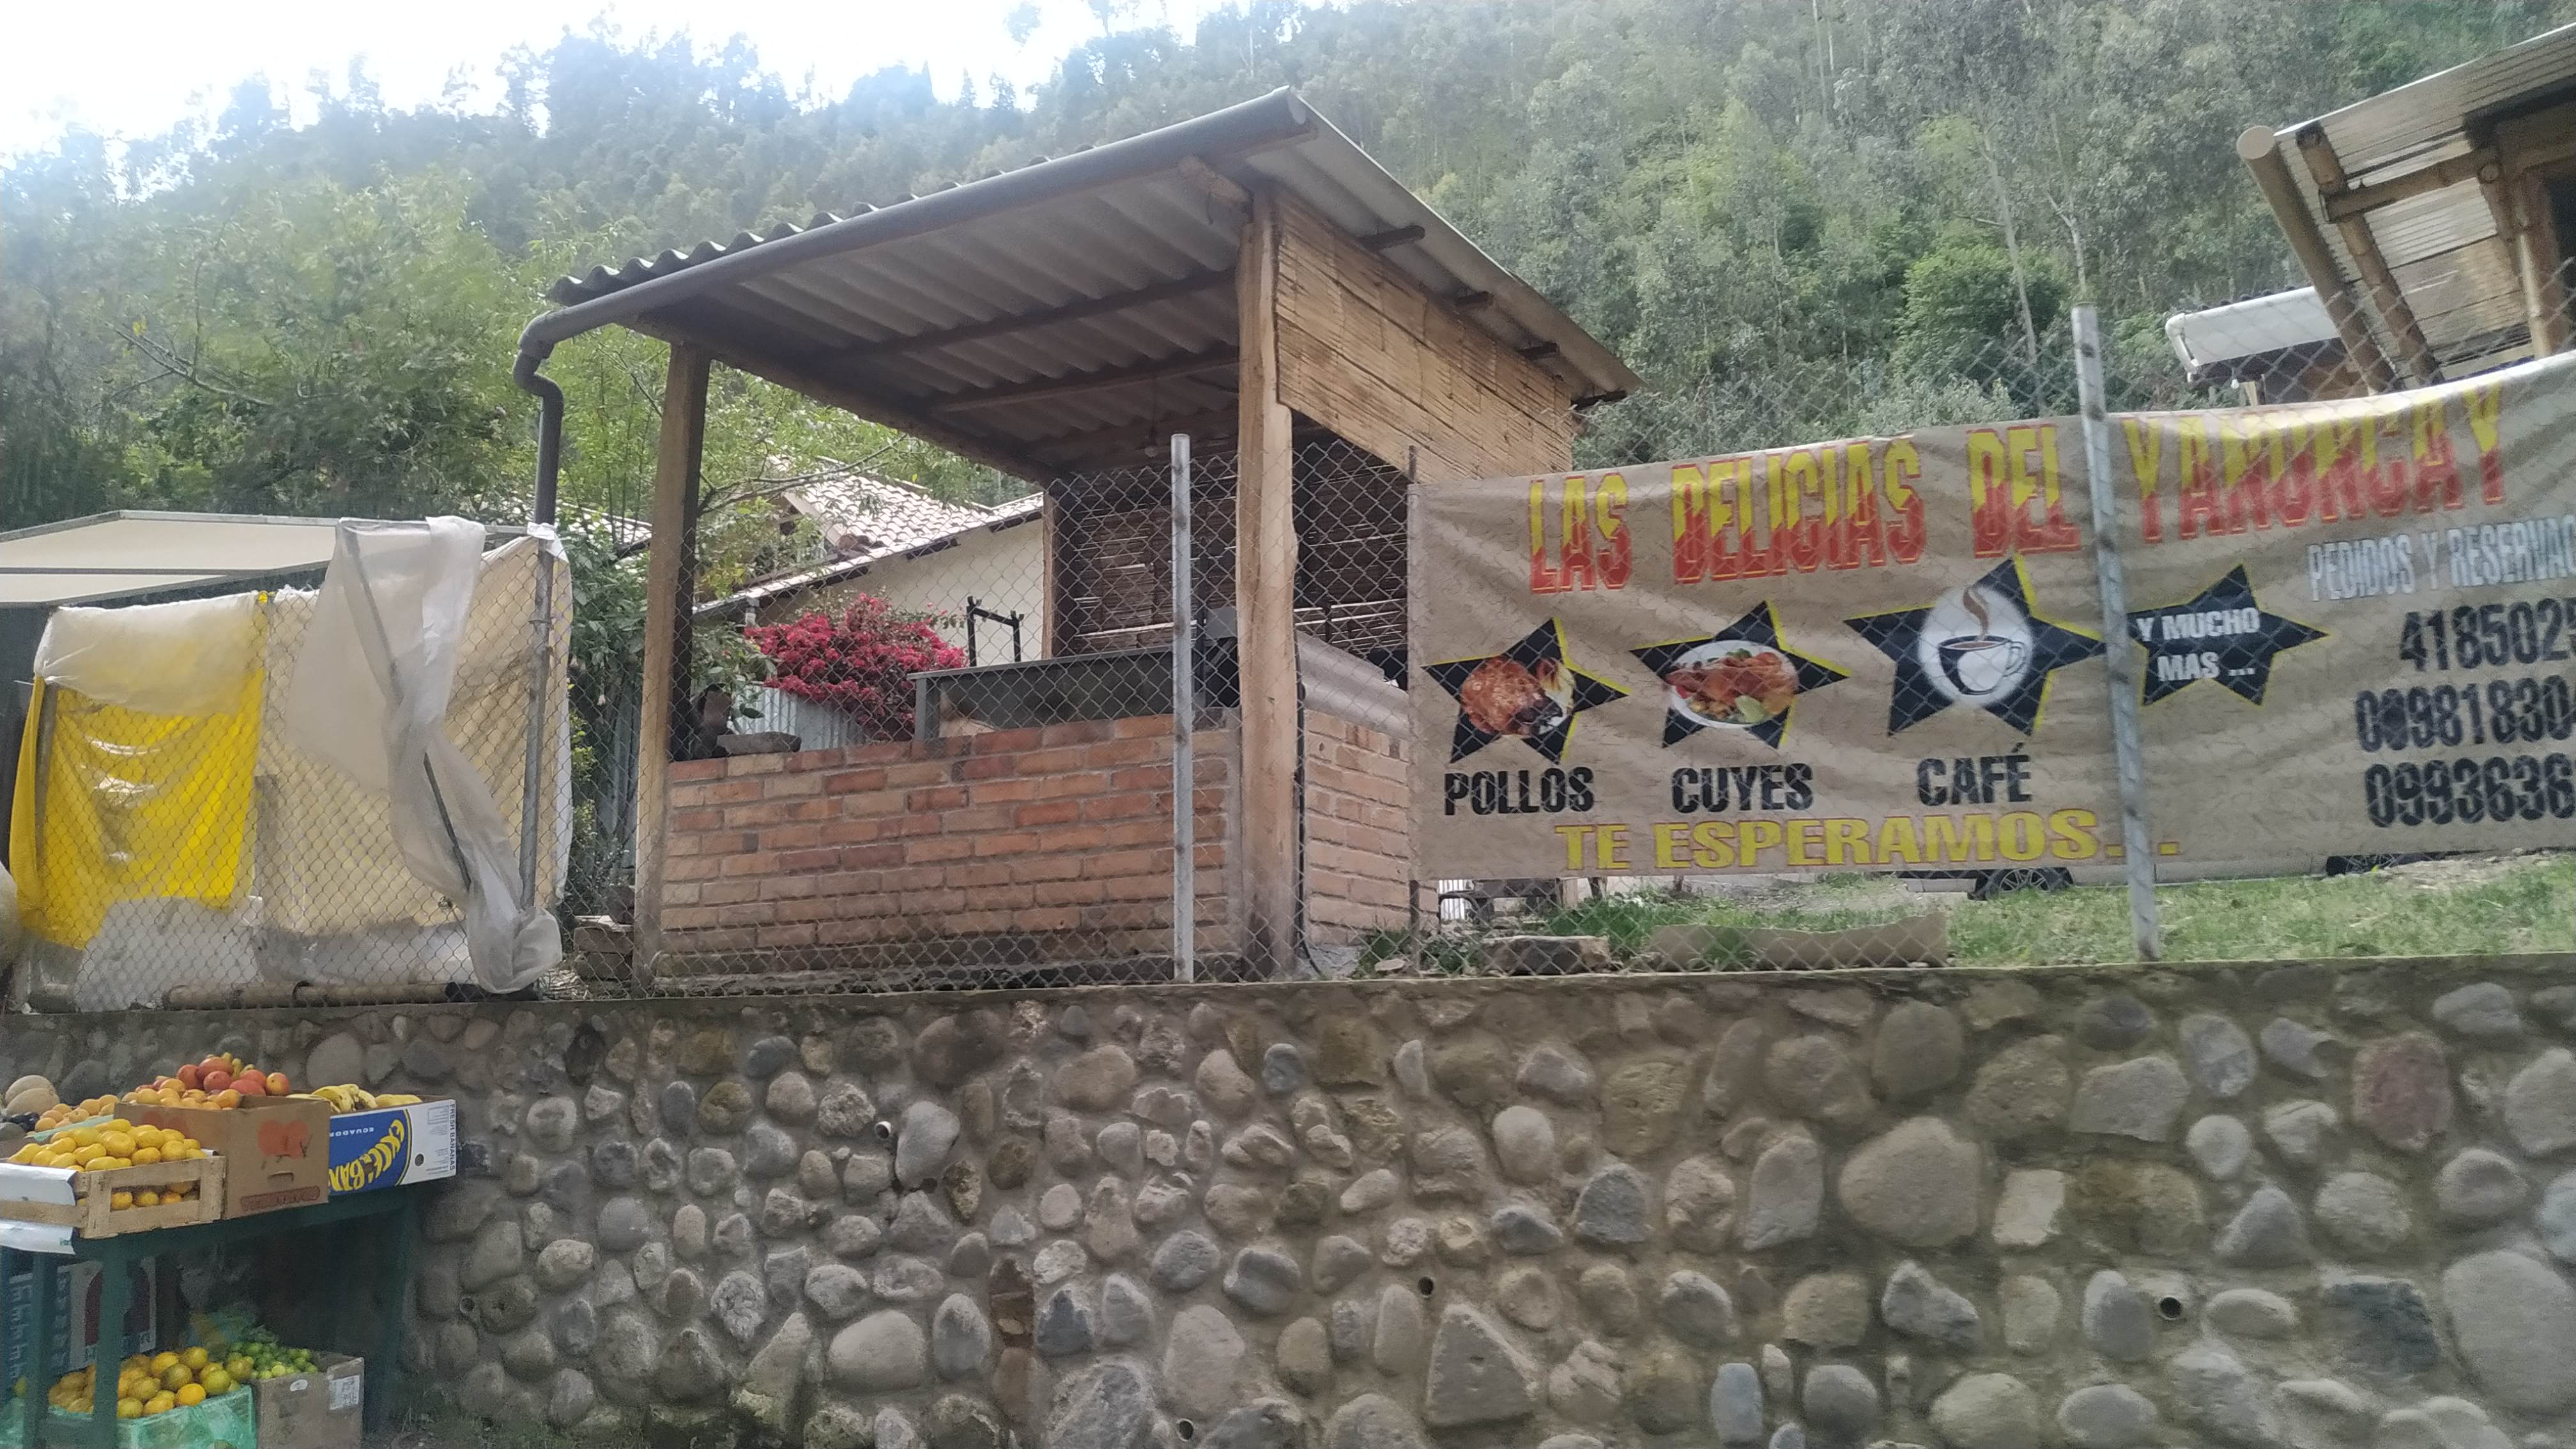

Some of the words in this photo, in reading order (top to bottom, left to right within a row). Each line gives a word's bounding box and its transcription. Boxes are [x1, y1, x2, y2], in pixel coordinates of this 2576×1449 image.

[1529, 472, 1632, 594] LAS
[1671, 437, 1926, 584] DELICIAS
[1967, 424, 2082, 559] DEL
[2306, 533, 2415, 602] PEDIDOS
[2421, 531, 2438, 590] Y
[2136, 617, 2154, 641] Y
[2161, 608, 2260, 640] MUCHO
[2157, 652, 2220, 682] MAS
[1444, 767, 1595, 816] POLLOS
[1671, 763, 1814, 812] CUYES
[1917, 742, 2032, 806] CAFÉ
[1554, 822, 1629, 870] TE
[1653, 808, 2180, 870] ESPERAMOS..
